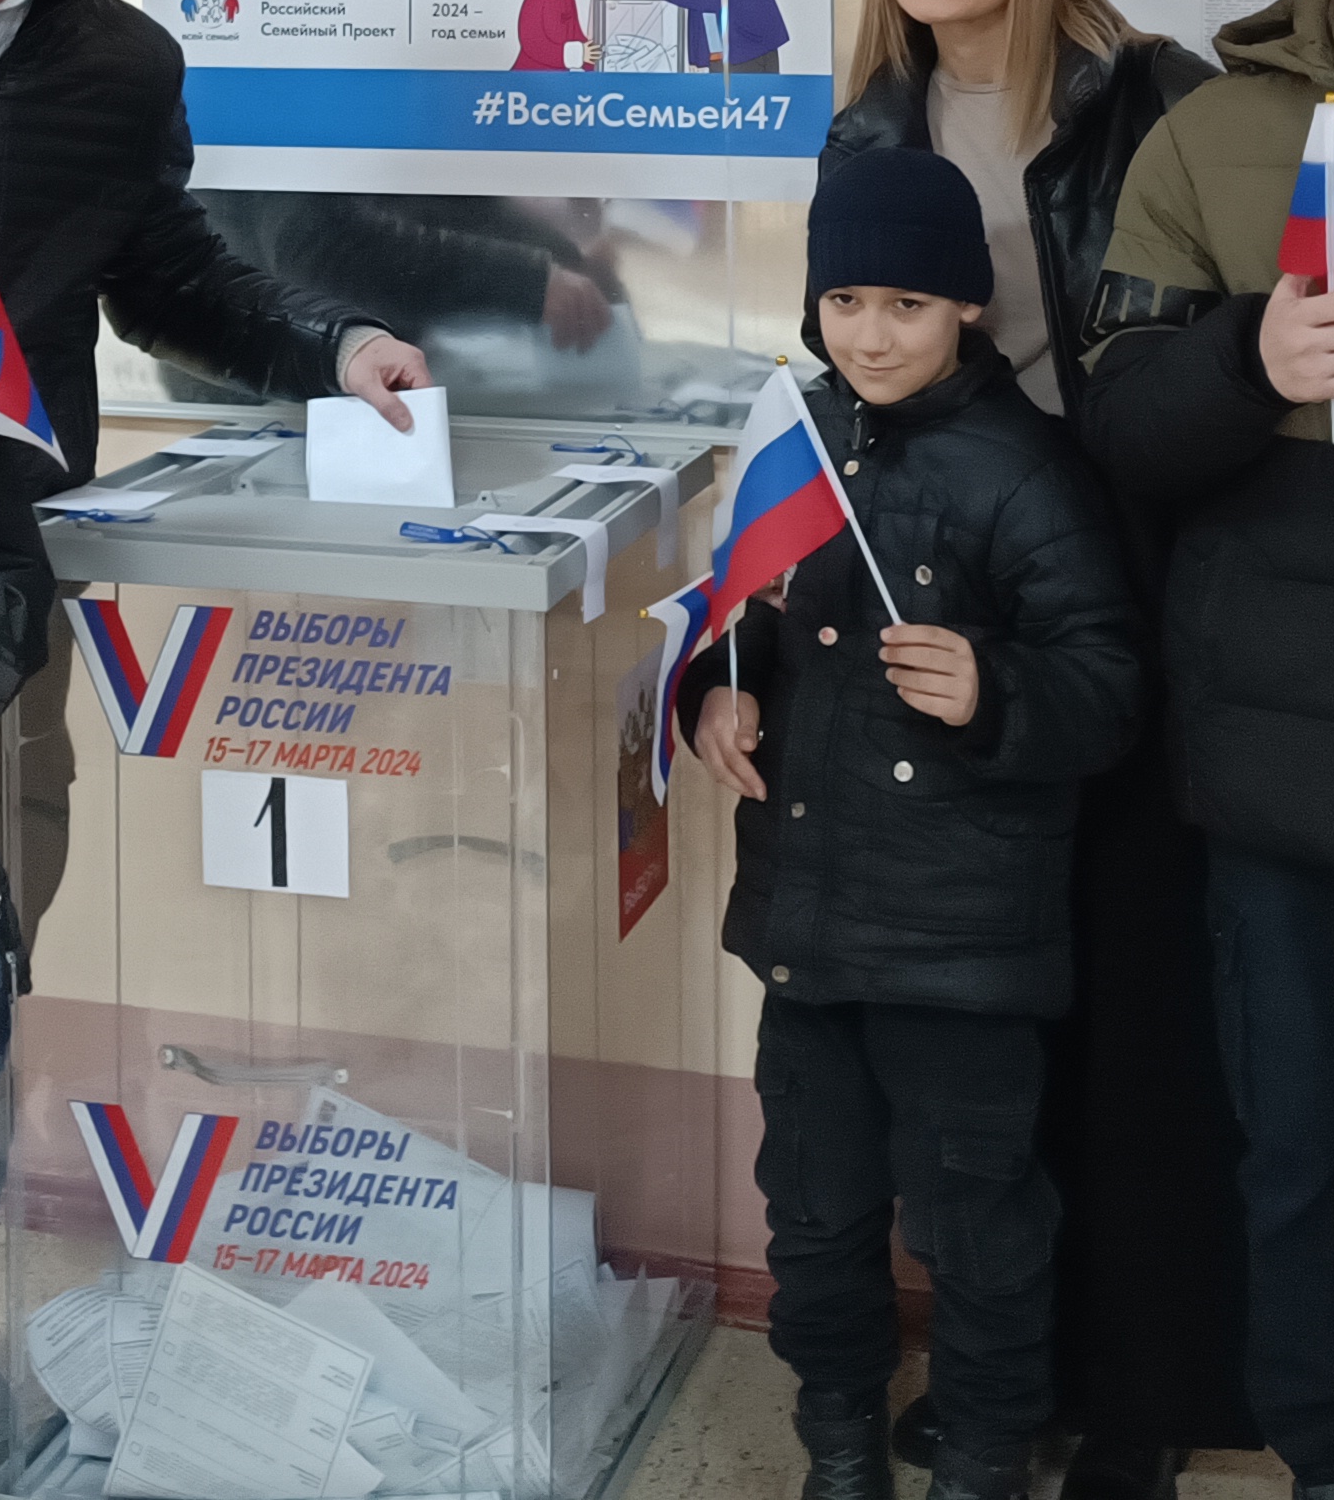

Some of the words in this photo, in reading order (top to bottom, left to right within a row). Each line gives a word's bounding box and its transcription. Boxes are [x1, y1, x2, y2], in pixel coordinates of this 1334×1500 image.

[261, 1, 346, 16] Российский
[432, 3, 468, 17] 2024
[261, 22, 338, 37] Семейный
[342, 24, 396, 41] Проект
[431, 28, 456, 40] год
[460, 28, 506, 39] семьи
[472, 91, 791, 130] #ВсейСемьей47
[249, 609, 406, 649] ВЫБОРЫ
[232, 652, 452, 696] ПРЕЗИДЕНТА
[215, 695, 357, 734] РОССИИ
[271, 741, 357, 773] МАРТА
[359, 747, 422, 777] 2024
[253, 776, 288, 888] 1
[255, 1120, 411, 1162] ВЫБОРЫ
[239, 1162, 458, 1210] ПРЕЗИДЕНТА
[223, 1203, 364, 1246] РОССИИ
[281, 1251, 365, 1284] МАРТА
[368, 1259, 430, 1290] 2024
